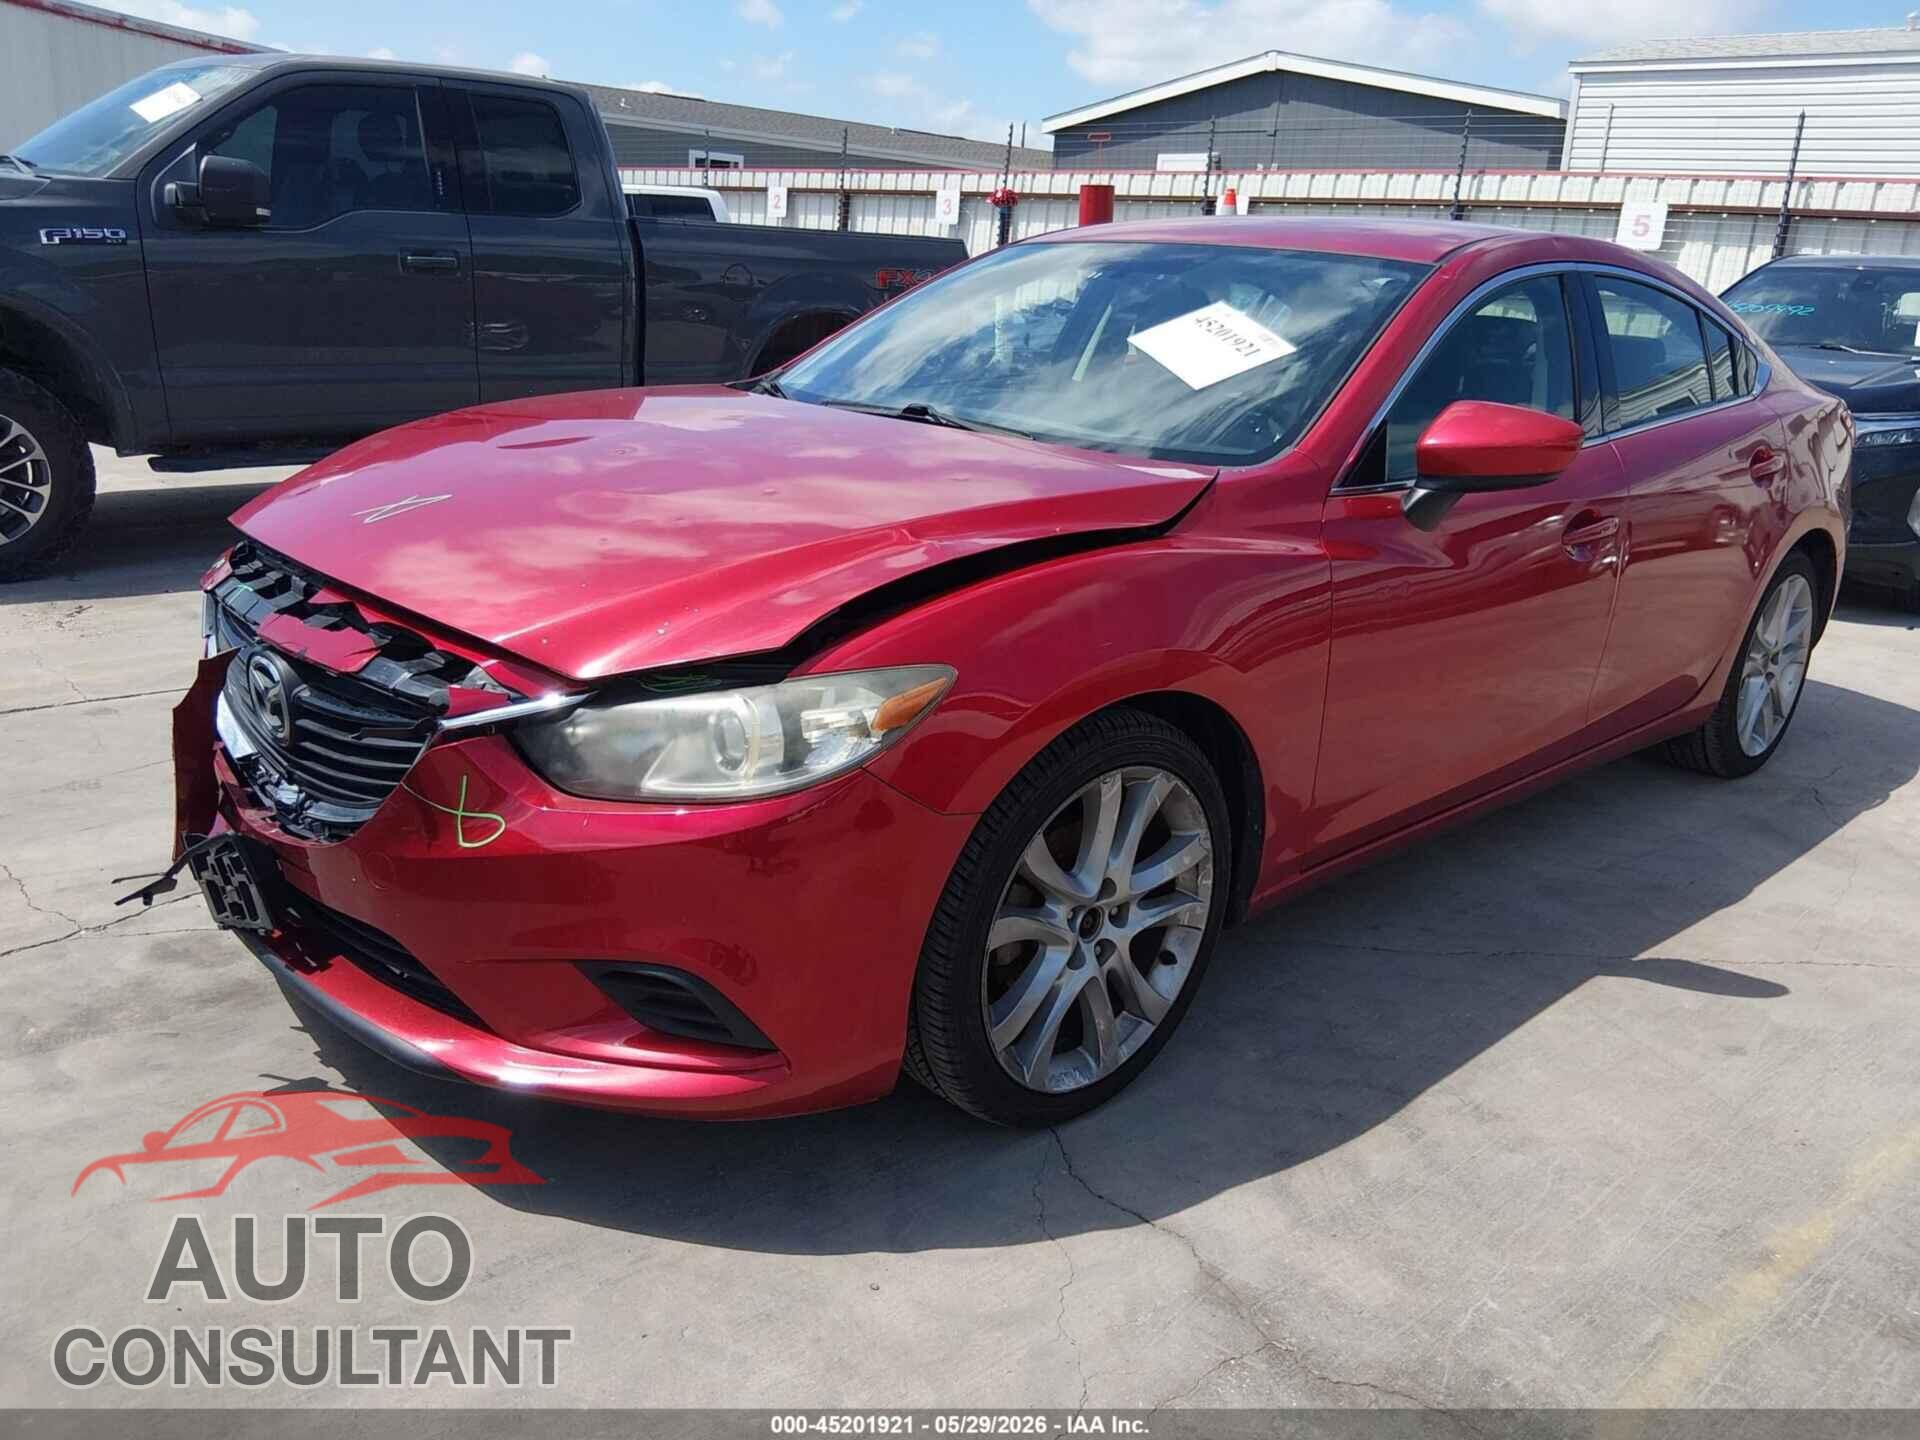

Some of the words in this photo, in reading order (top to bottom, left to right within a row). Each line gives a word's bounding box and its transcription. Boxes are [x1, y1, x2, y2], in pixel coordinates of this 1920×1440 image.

[773, 193, 782, 209] 2
[942, 198, 953, 215] 3
[1632, 214, 1651, 238] 5
